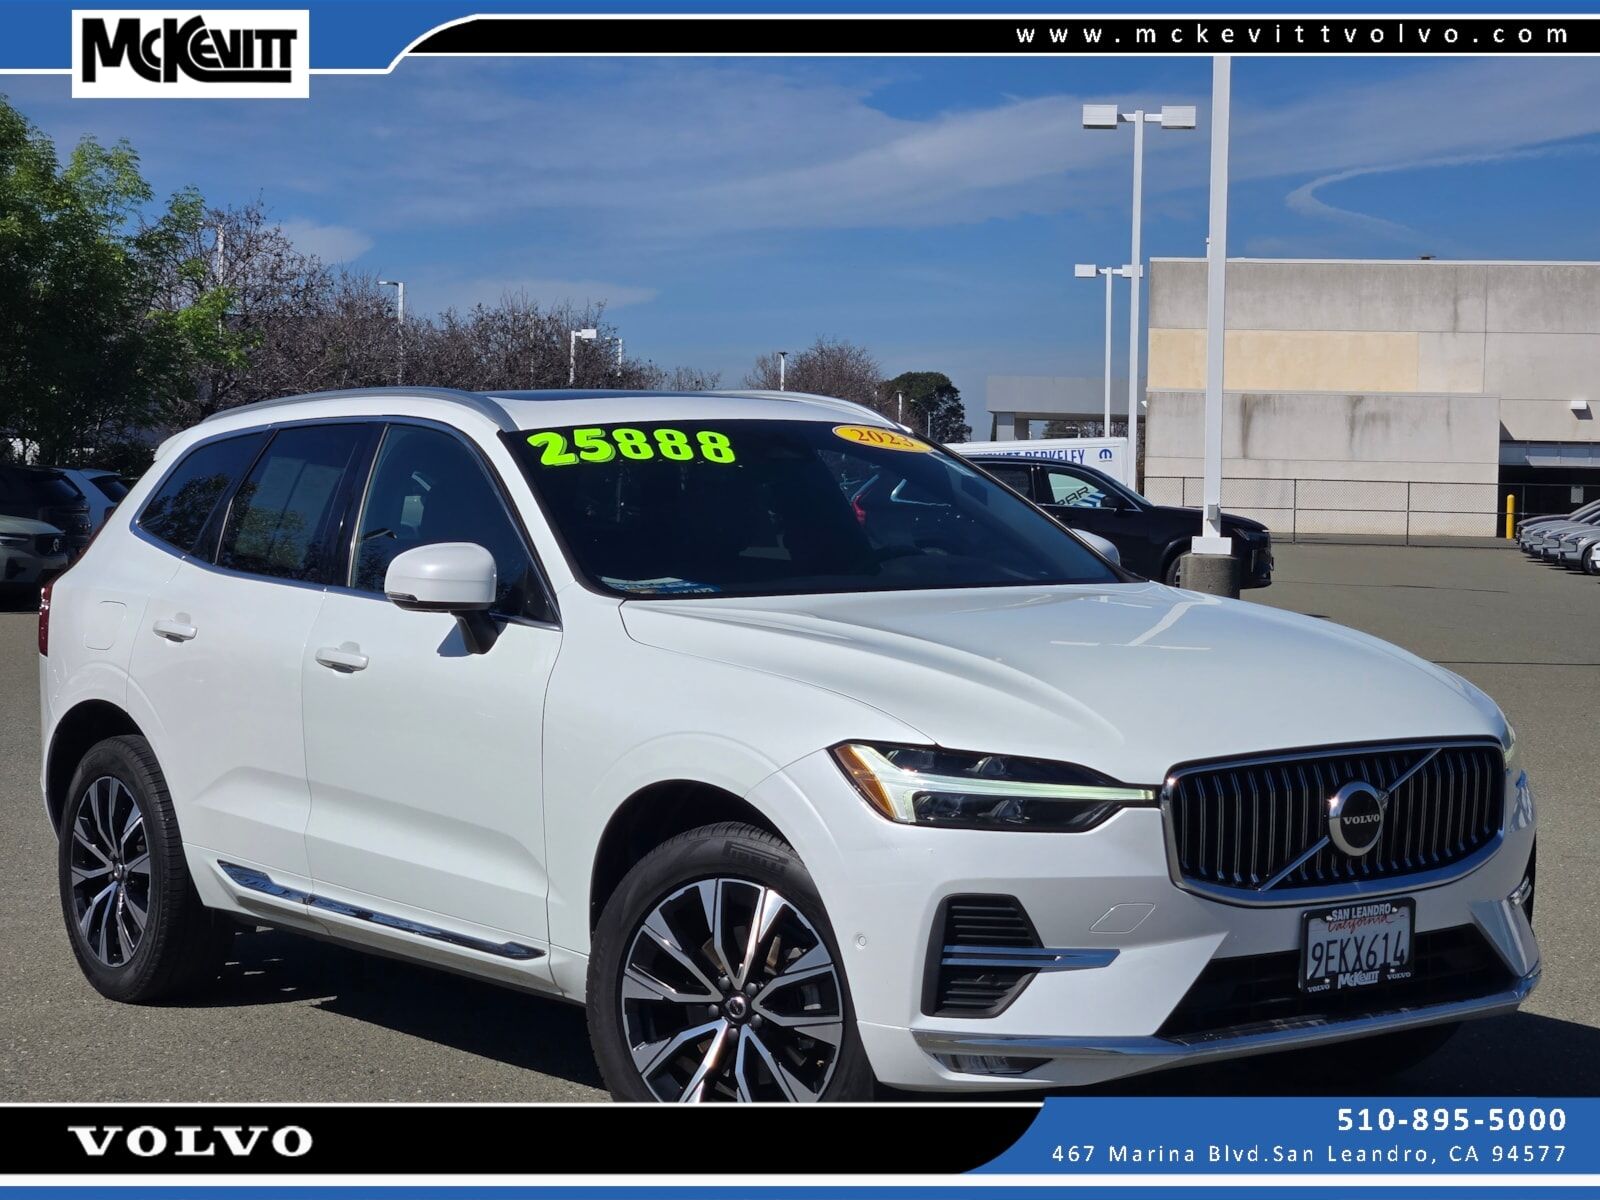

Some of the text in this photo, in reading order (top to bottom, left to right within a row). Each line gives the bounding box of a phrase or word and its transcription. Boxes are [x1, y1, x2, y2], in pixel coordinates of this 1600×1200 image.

[527, 428, 736, 466] 25888
[850, 428, 914, 447] 2023
[1343, 814, 1380, 825] VOLVO
[1331, 903, 1391, 921] SAN LEANDRO
[1311, 930, 1406, 979] 9EKX614
[1307, 983, 1331, 992] VOLVO
[1387, 971, 1411, 980] VOLVO
